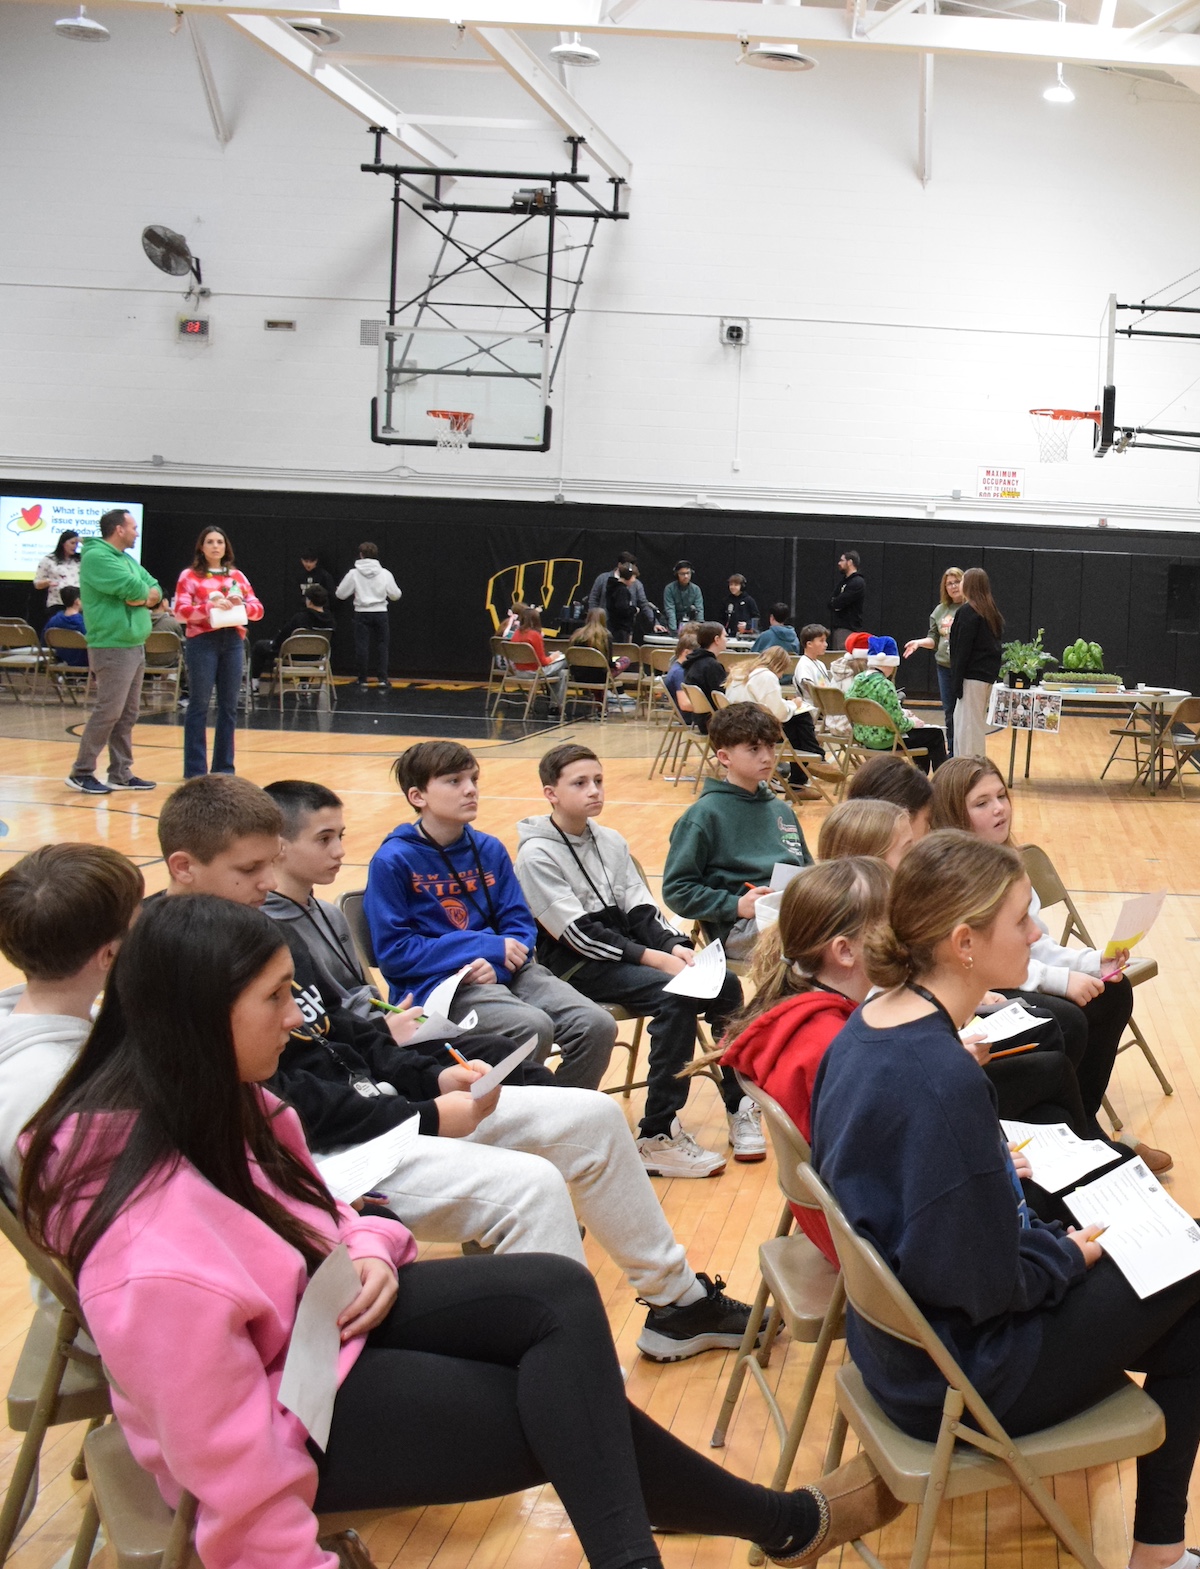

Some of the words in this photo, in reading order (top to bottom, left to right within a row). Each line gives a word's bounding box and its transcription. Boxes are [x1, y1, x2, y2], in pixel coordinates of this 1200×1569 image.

[986, 470, 1017, 478] MAXIMUM
[982, 478, 1019, 486] OCCUPANCY
[52, 506, 75, 515] What
[77, 506, 84, 515] is
[86, 507, 100, 516] the
[51, 515, 73, 524] issue
[75, 518, 100, 528] young
